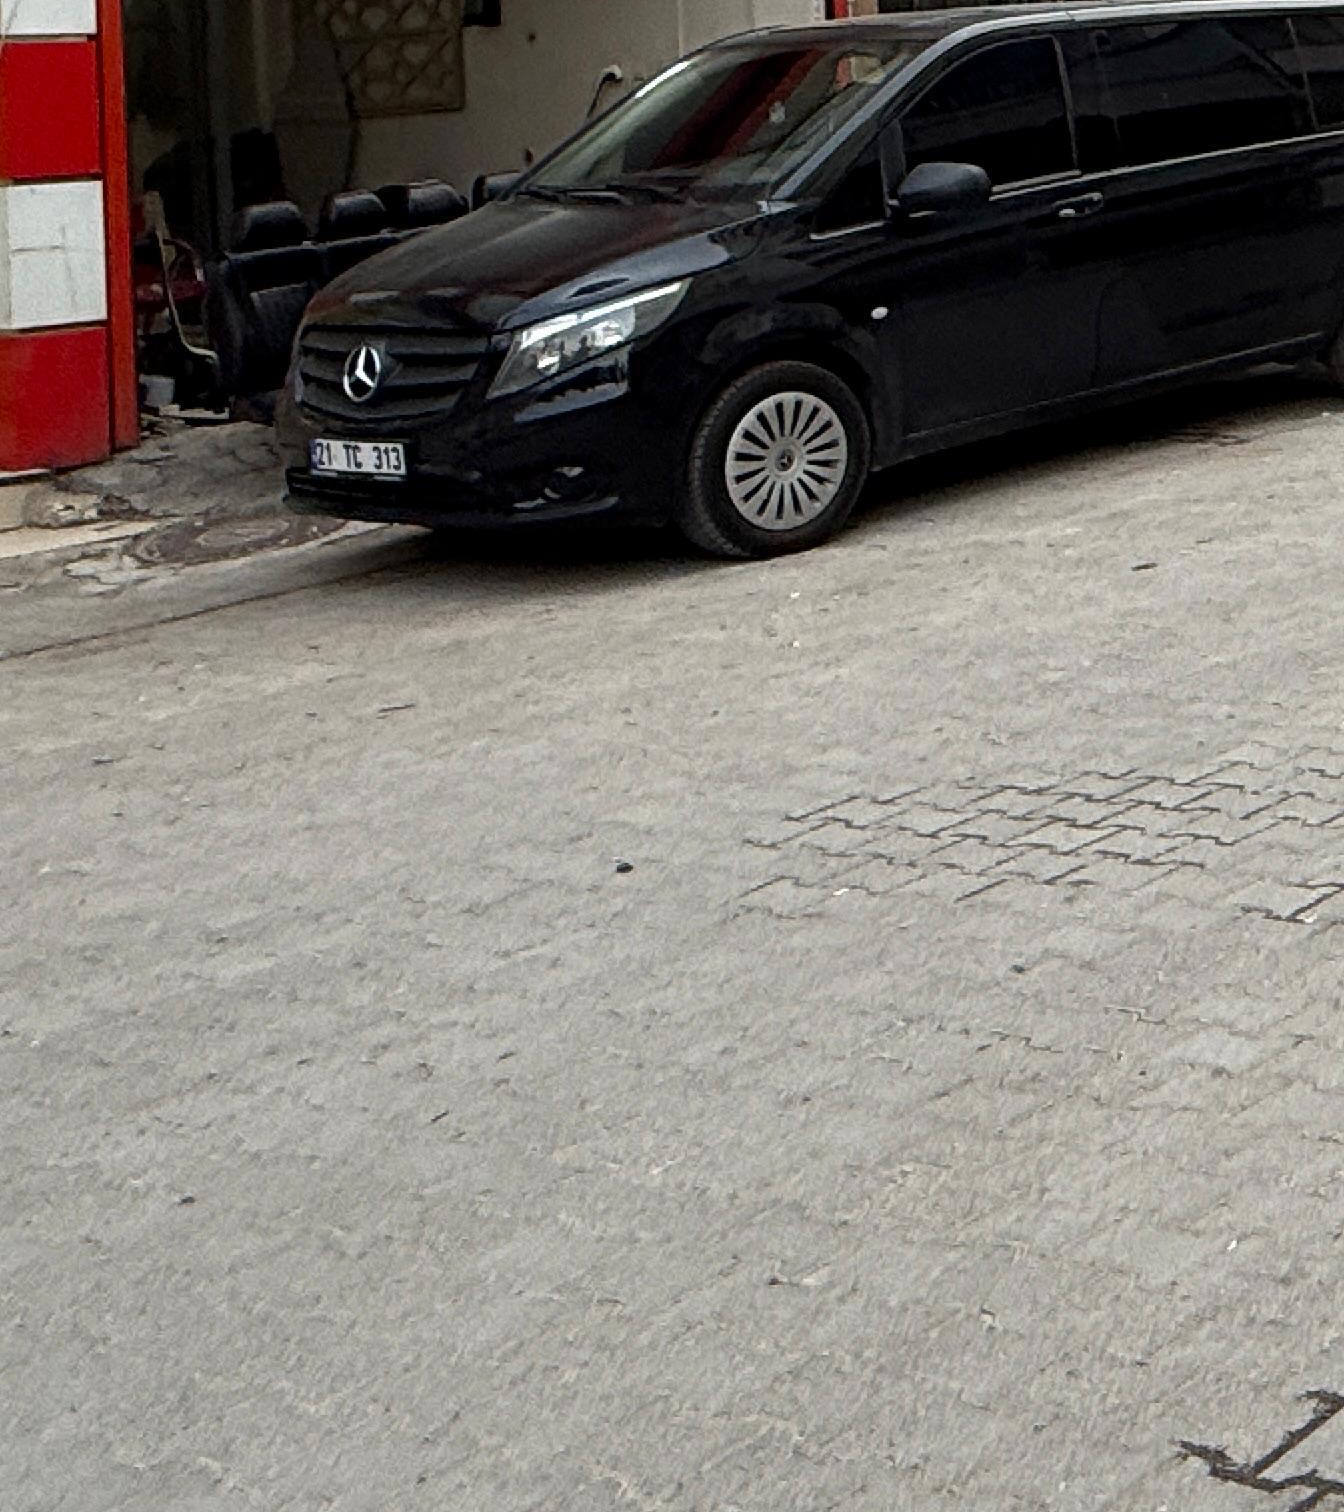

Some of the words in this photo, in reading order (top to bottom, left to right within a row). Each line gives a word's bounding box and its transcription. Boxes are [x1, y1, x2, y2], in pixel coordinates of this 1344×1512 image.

[314, 442, 332, 466] 21
[342, 443, 363, 469] TC
[372, 445, 402, 471] 313
